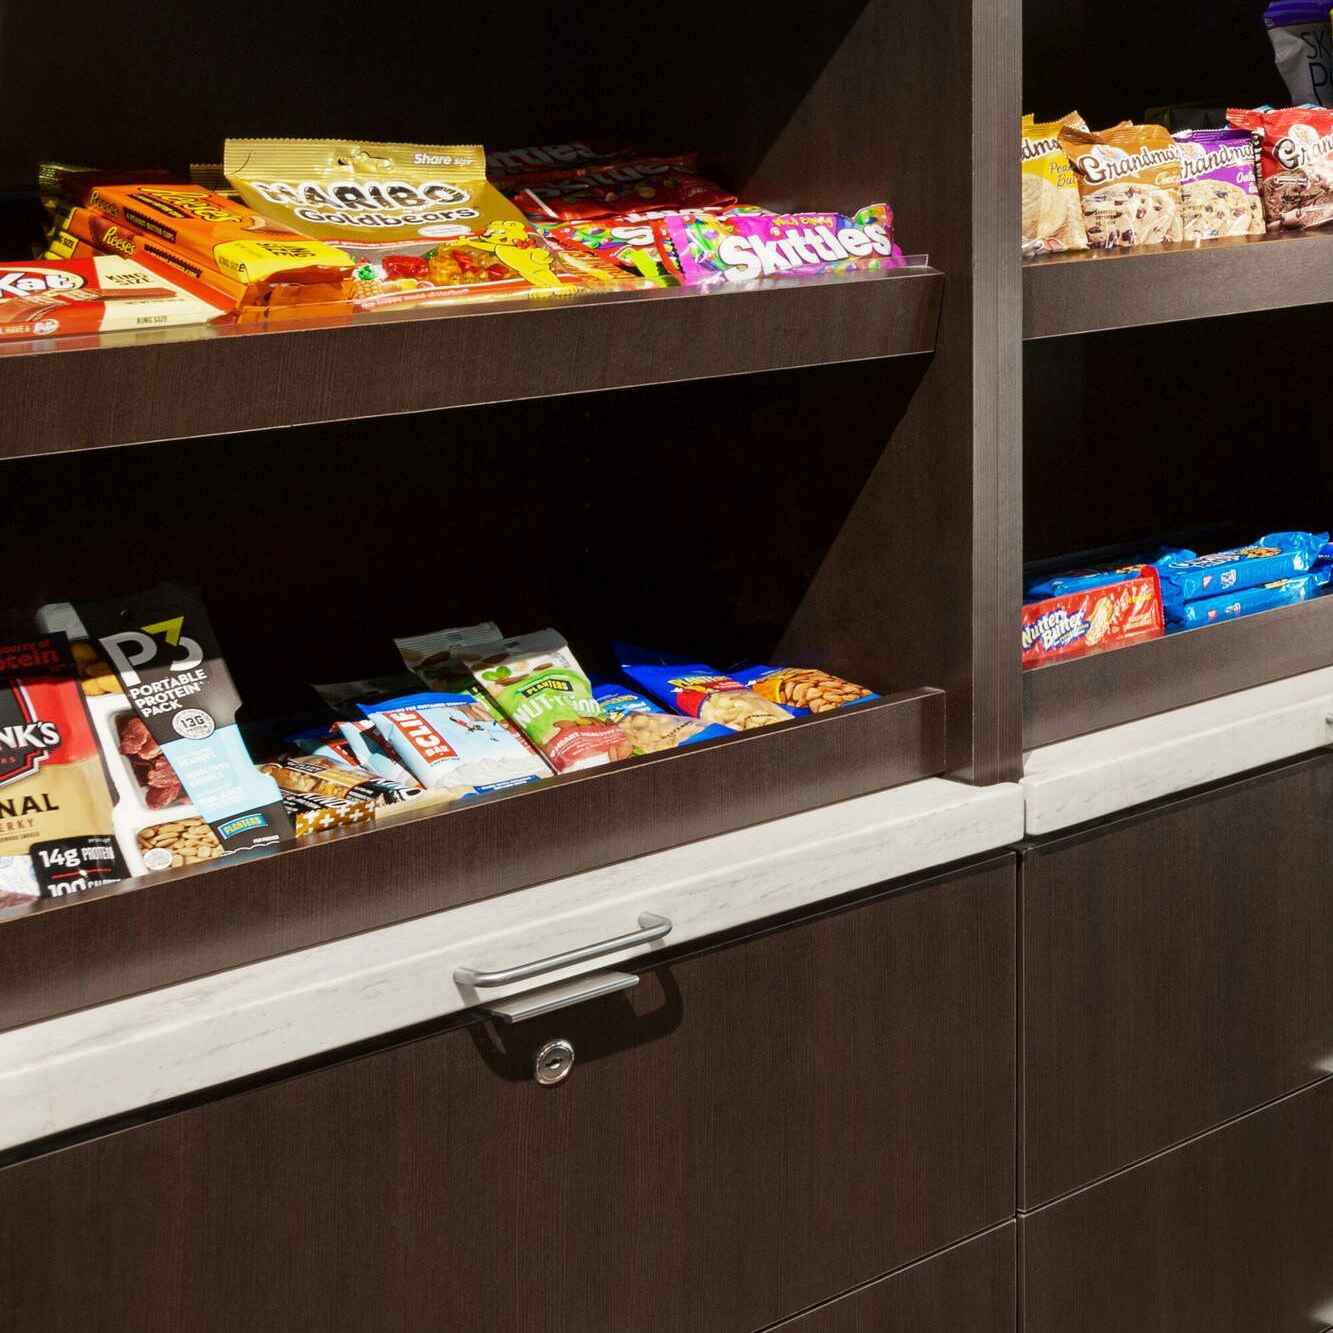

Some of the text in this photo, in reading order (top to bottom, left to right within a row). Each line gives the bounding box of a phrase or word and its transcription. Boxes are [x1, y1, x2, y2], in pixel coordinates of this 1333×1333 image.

[414, 152, 452, 166] Share
[140, 187, 242, 222] Reese's
[249, 178, 470, 211] HARIBO
[296, 206, 478, 227] Goldbears
[103, 226, 136, 255] Reese's
[719, 223, 892, 282] Skittles
[137, 314, 168, 325] KING SIZE
[1022, 608, 1064, 648] Nutter
[1042, 609, 1085, 650] Butter
[99, 616, 204, 686] P3
[130, 669, 208, 700] PORTABLE
[135, 682, 201, 709] PROTEIN
[526, 679, 570, 695] PLANTERS
[141, 698, 183, 718] PACK
[180, 715, 205, 728] 13G
[390, 709, 441, 748] CLIF
[425, 745, 450, 757] BAR
[38, 844, 115, 868] 14g PROTEIN
